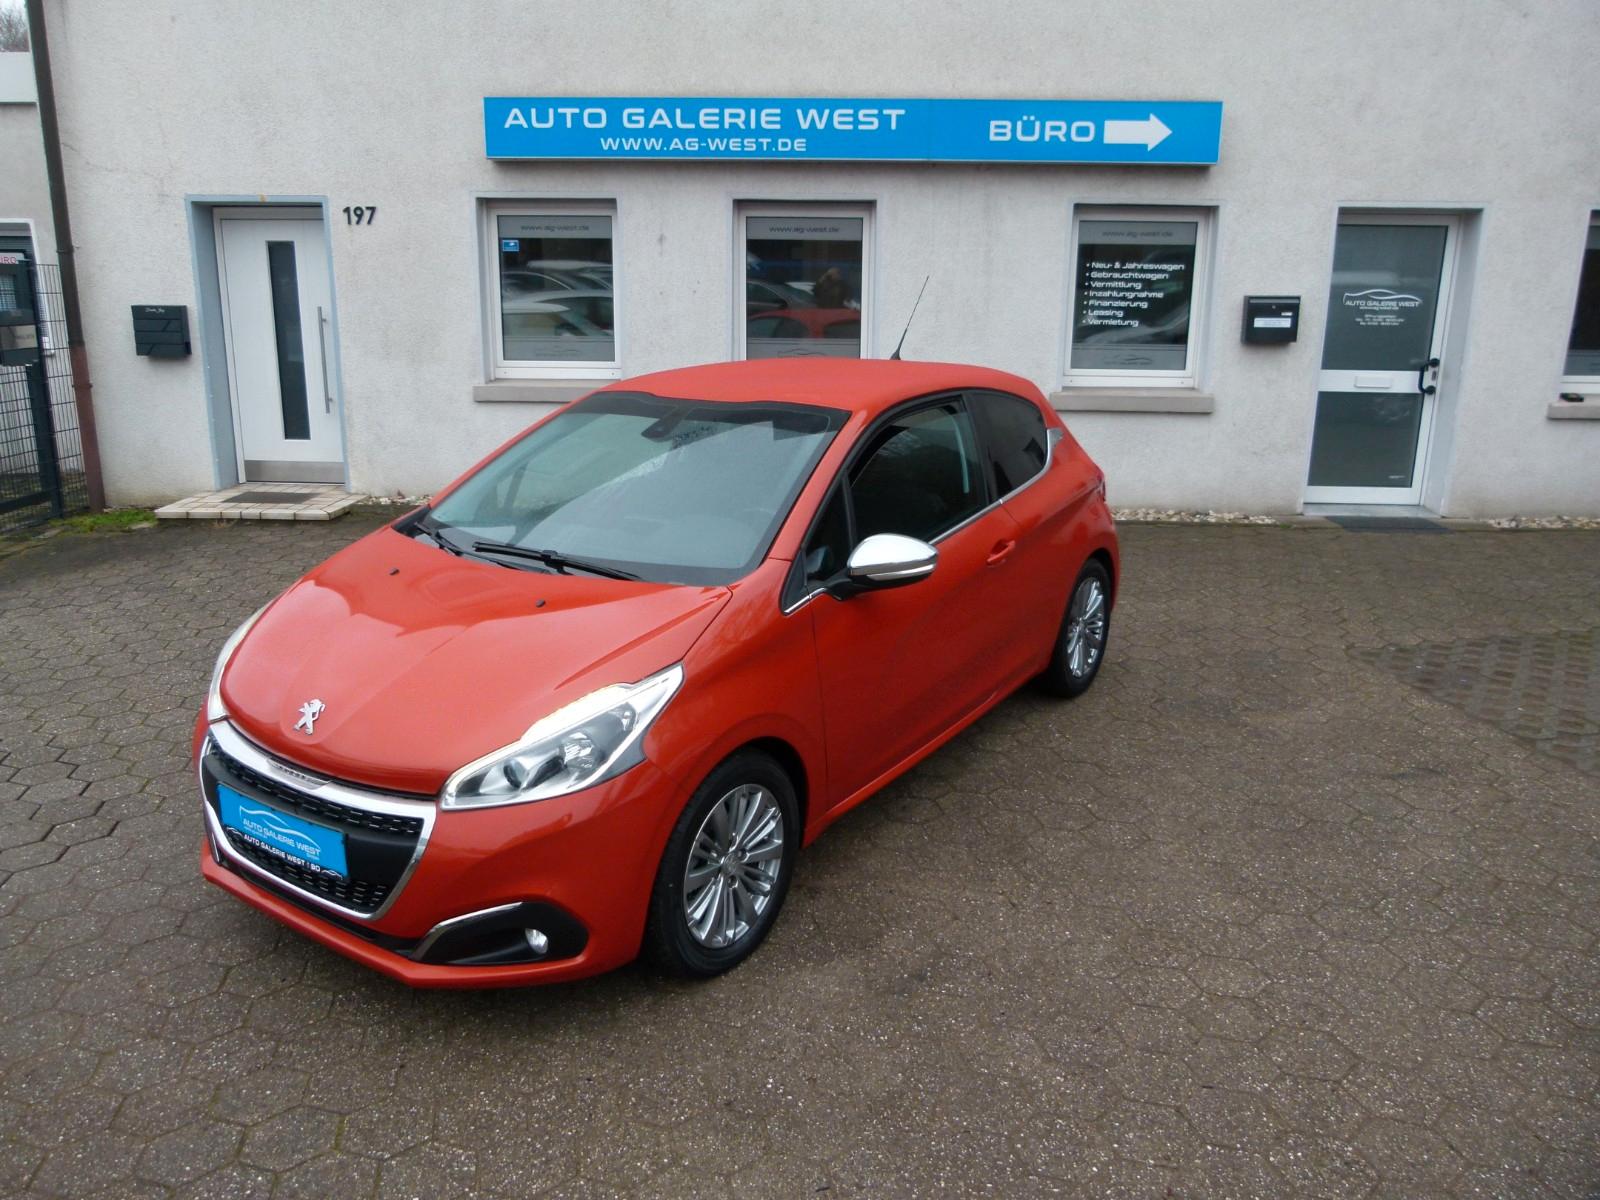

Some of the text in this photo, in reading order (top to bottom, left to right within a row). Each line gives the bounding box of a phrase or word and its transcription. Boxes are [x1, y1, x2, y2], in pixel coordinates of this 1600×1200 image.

[503, 108, 907, 130] AUTO GALERIE WEST
[989, 115, 1096, 142] BÜRO
[600, 137, 807, 152] WWW.AG-WEST.DE
[343, 206, 377, 225] 197
[1122, 263, 1185, 271] Jahreswagen
[1090, 271, 1169, 280] Gebrauchtwagen
[1090, 281, 1142, 289] Vermittlung
[1089, 290, 1164, 298] Inzahlungnahme
[1088, 300, 1148, 308] Finanzierung
[1088, 309, 1124, 317] Leasing
[1087, 318, 1139, 327] Vermietung
[243, 818, 264, 832] AUTO
[263, 827, 295, 847] GALERIE
[296, 842, 321, 856] WEST
[243, 834, 260, 847] AUTO
[260, 842, 286, 858] GALERIE
[286, 853, 306, 866] WEST
